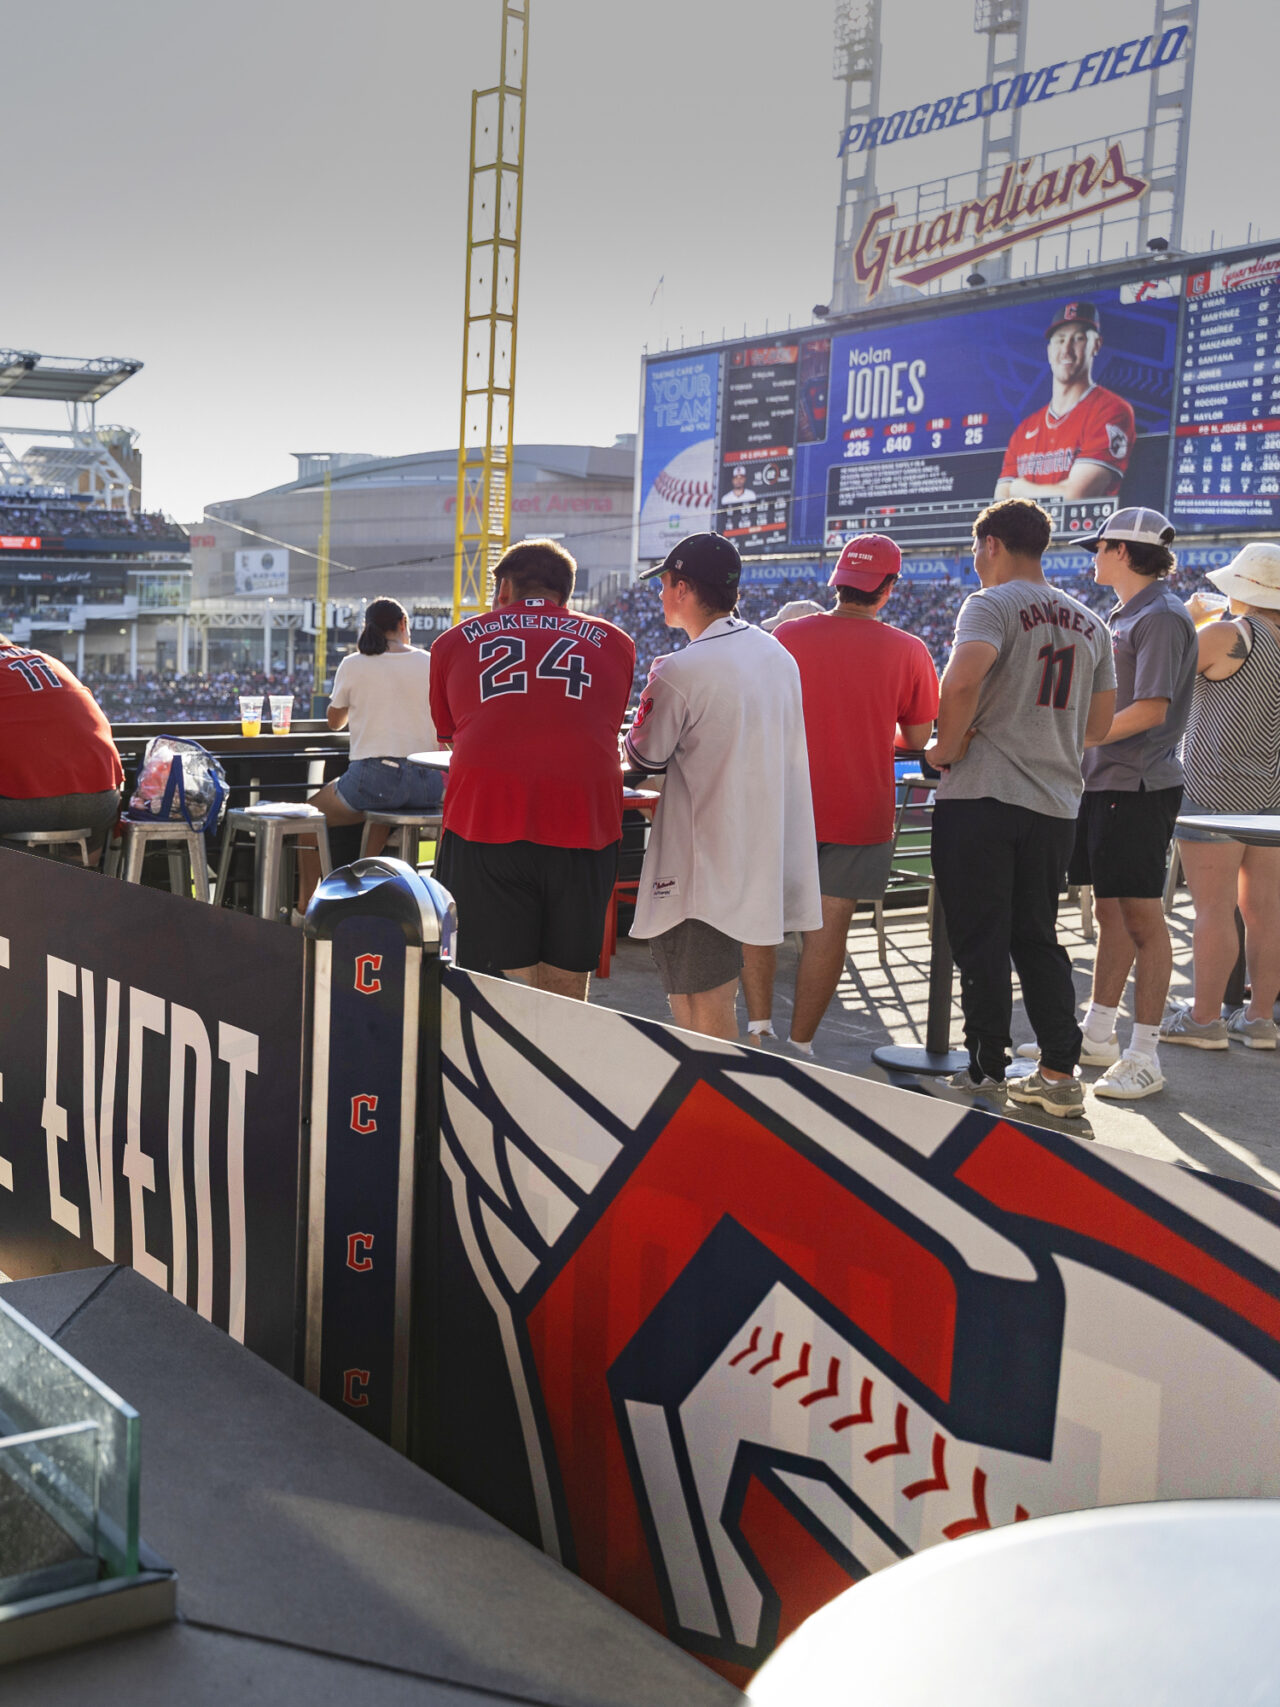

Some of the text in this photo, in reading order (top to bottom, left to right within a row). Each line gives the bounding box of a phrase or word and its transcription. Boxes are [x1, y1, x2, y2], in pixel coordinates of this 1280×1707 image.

[836, 25, 1189, 158] PROGRESSIVE FIELD
[853, 140, 1150, 303] Guardians
[849, 346, 892, 367] Nolan
[652, 373, 711, 403] YOUR
[842, 359, 927, 423] JONES
[654, 398, 711, 427] TEAM
[696, 422, 711, 432] YOU
[1220, 422, 1247, 433] JONES
[843, 427, 984, 458] .225 .640 3 25
[849, 427, 867, 439] AVG
[546, 494, 613, 513] Arena
[1102, 503, 1111, 517] 0
[750, 565, 816, 580] HONDA
[901, 561, 949, 575] NDA
[461, 613, 608, 648] McKENZIE
[7, 657, 63, 692] 11
[478, 635, 592, 704] 24
[1035, 643, 1076, 711] 11
[353, 952, 384, 995] C
[349, 1093, 379, 1135] C
[41, 953, 260, 1347] EVENT
[345, 1231, 375, 1273] C
[342, 1368, 371, 1409] C
